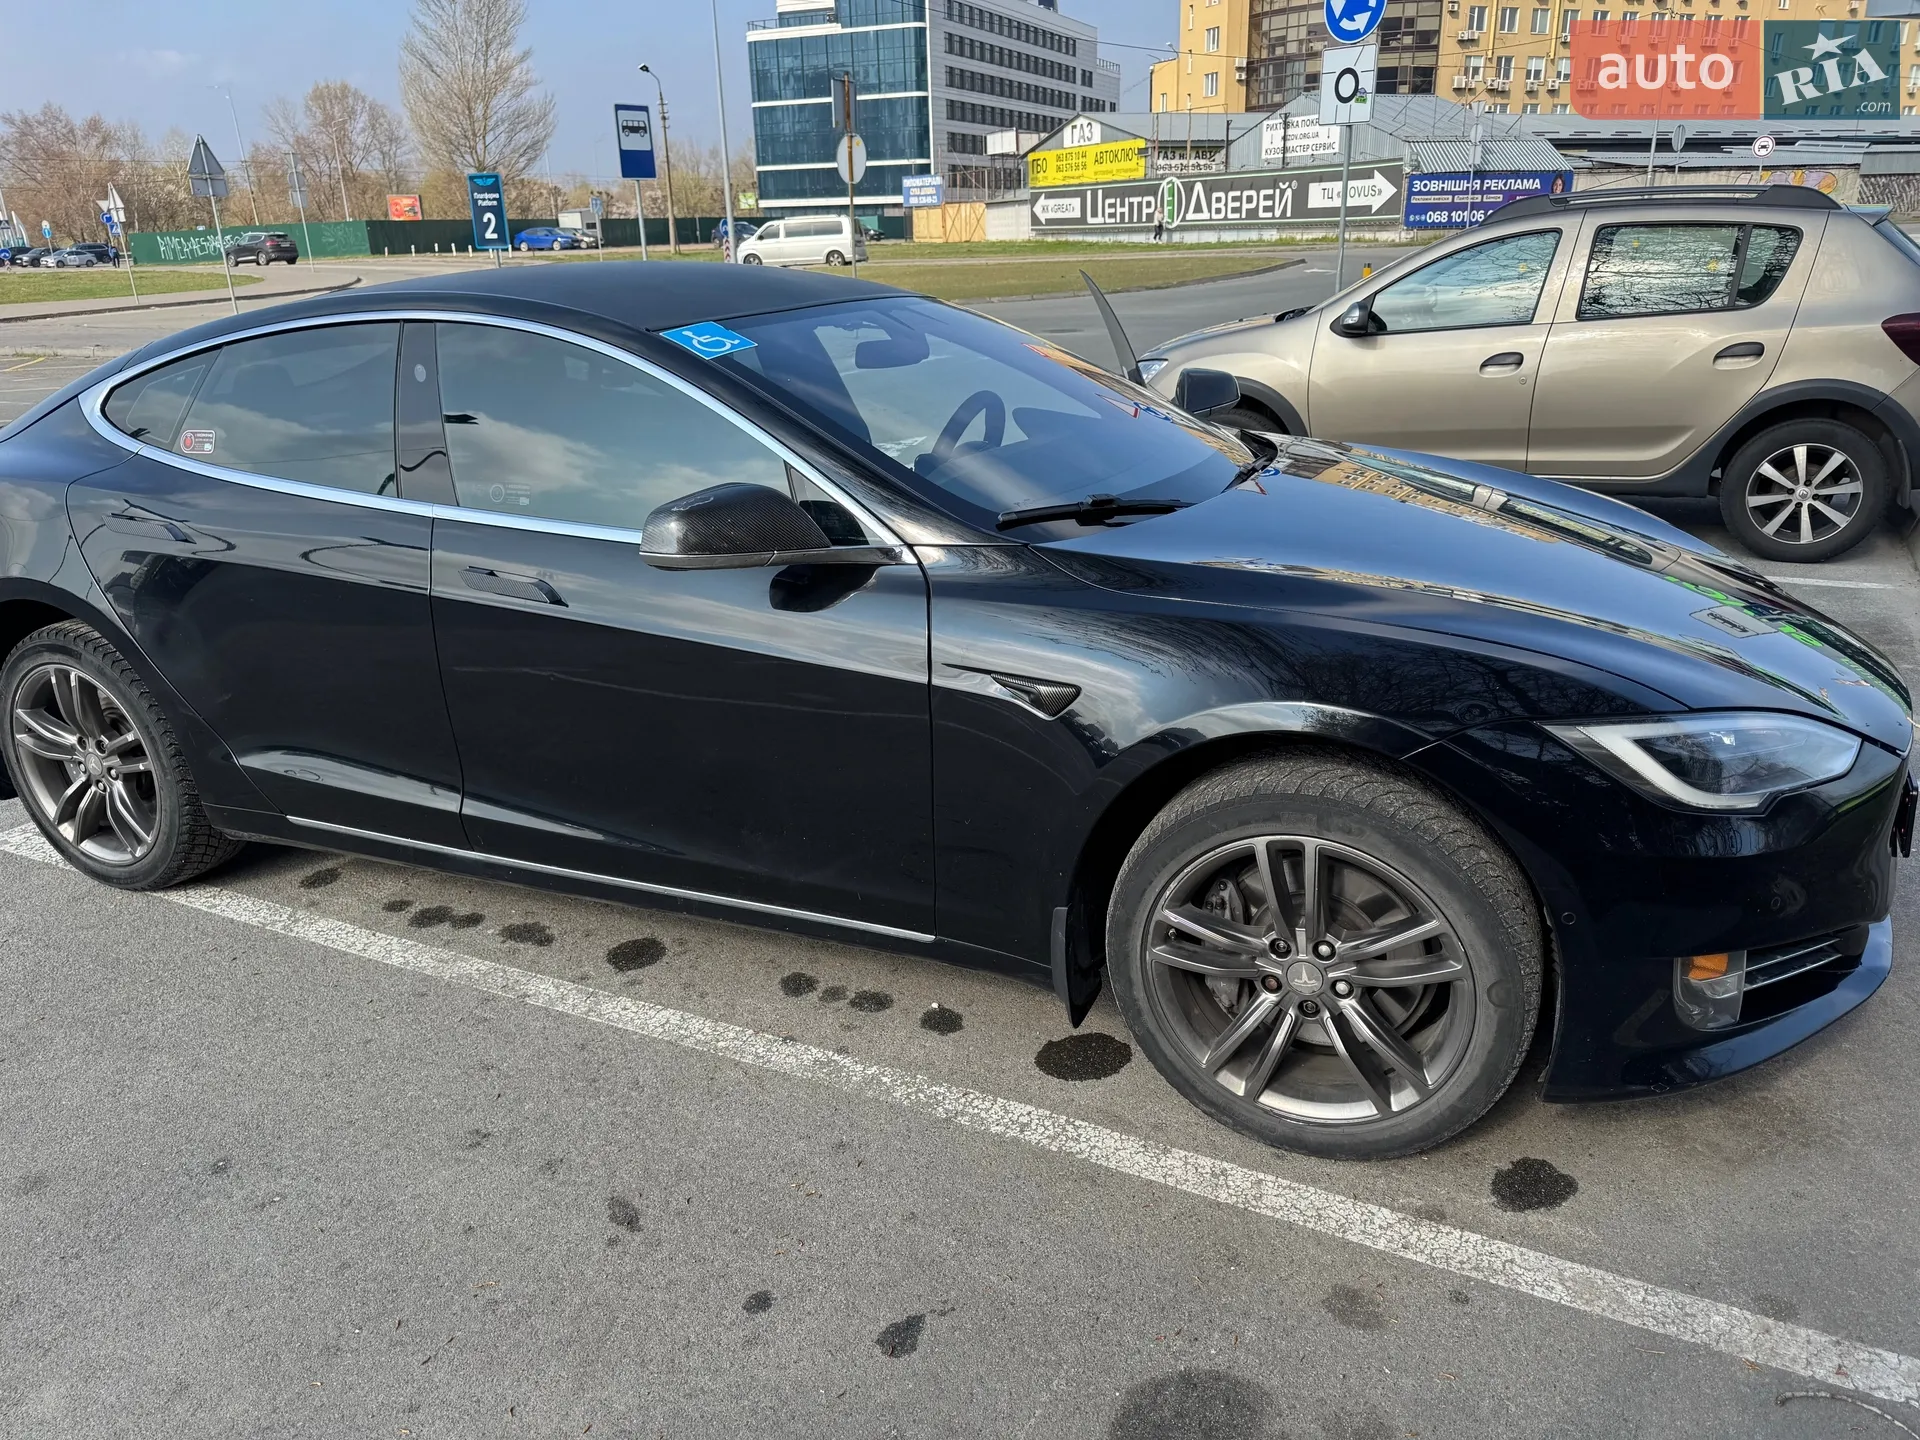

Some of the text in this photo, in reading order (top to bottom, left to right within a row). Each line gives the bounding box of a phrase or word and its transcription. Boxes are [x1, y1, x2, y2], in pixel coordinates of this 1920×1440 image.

[1301, 118, 1319, 128] ПОКР
[1071, 122, 1093, 144] ГАЗ
[1311, 141, 1336, 152] СЕРВИС
[1157, 150, 1176, 160] ГАЗ
[1194, 150, 1213, 160] АВТ
[1031, 157, 1048, 175] ГБО
[1412, 178, 1541, 192] ЗОВНІШНЯ РЕКЛАМА
[1321, 184, 1382, 201] ТЦ «OVUS»
[1041, 204, 1050, 213] ЖК
[1426, 210, 1448, 223] 068
[1450, 210, 1468, 223] 101
[1470, 210, 1485, 222] 06
[482, 212, 498, 239] 2
